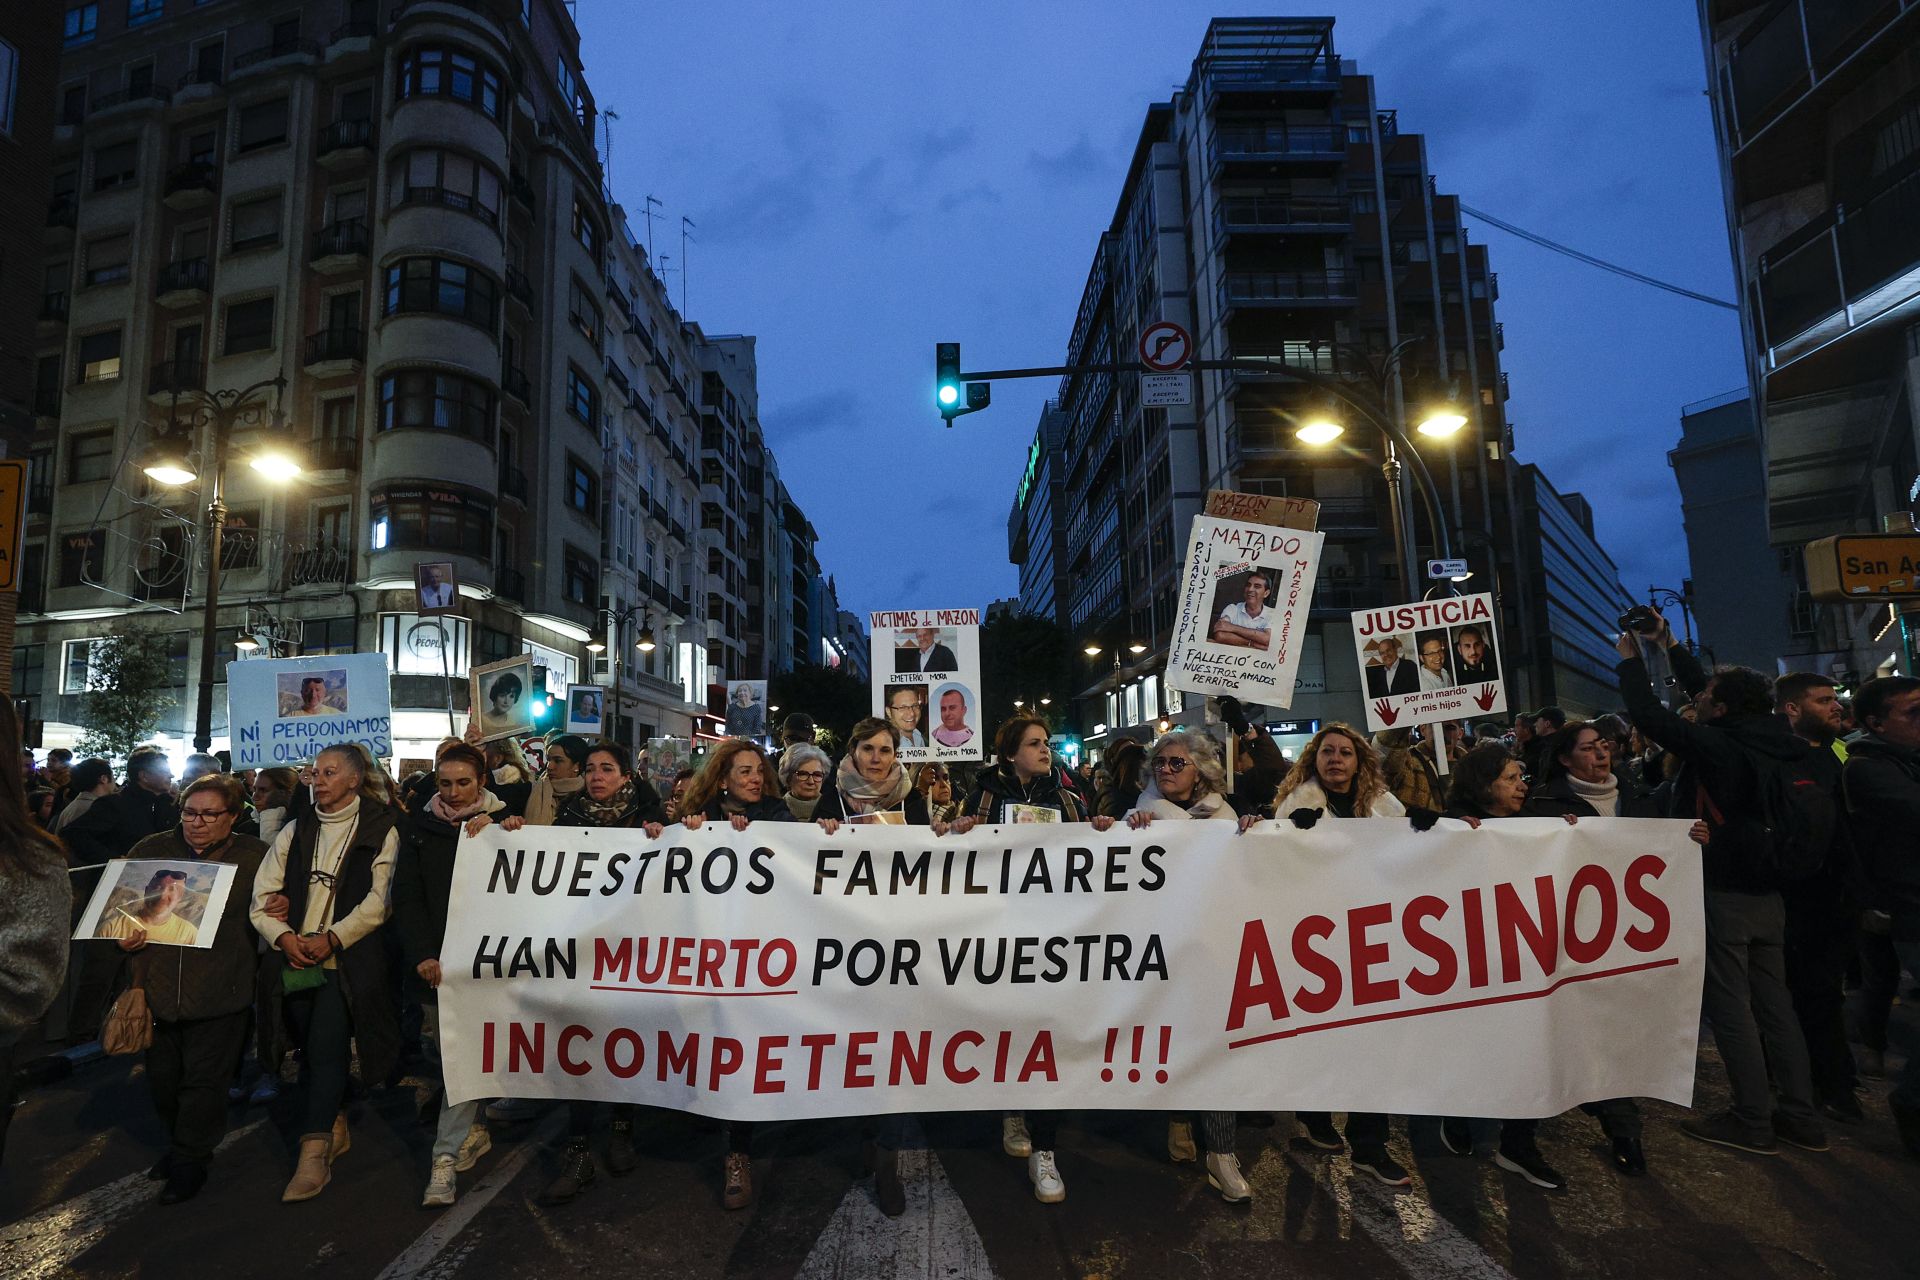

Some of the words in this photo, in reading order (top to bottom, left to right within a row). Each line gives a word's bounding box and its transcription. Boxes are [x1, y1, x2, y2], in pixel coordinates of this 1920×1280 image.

[428, 491, 462, 504] VILA
[1212, 504, 1227, 515] LO
[68, 537, 97, 549] VILA
[1211, 527, 1301, 555] MATADO
[1846, 556, 1889, 575] San
[871, 611, 918, 628] VICTIMAS
[922, 613, 933, 627] de
[937, 610, 979, 626] MAZON
[1359, 597, 1490, 636] JUSTICIA
[1186, 648, 1251, 667] FALLECIÓ
[1253, 660, 1277, 670] CON
[930, 673, 948, 681] MORA
[1183, 662, 1237, 679] NUESTROS
[1239, 672, 1277, 686] AMADOS
[1404, 694, 1420, 705] por
[1422, 690, 1434, 700] mi
[1435, 686, 1467, 699] marido
[1413, 706, 1419, 715] y
[1421, 704, 1438, 713] mis
[1439, 700, 1462, 712] hijos
[272, 716, 390, 738] PERDONAMOS
[906, 749, 928, 758] MORA
[961, 748, 978, 756] MORA
[487, 847, 775, 896] NUESTROS
[813, 845, 1167, 896] FAMILIARES
[1225, 854, 1671, 1032] ASESINOS
[472, 935, 577, 980] HAN
[592, 936, 797, 988] MUERTO
[811, 938, 921, 987] POR
[938, 934, 1169, 986] VUESTRA
[481, 1022, 1059, 1095] INCOMPETENCIA
[1100, 1025, 1172, 1085] !!!
